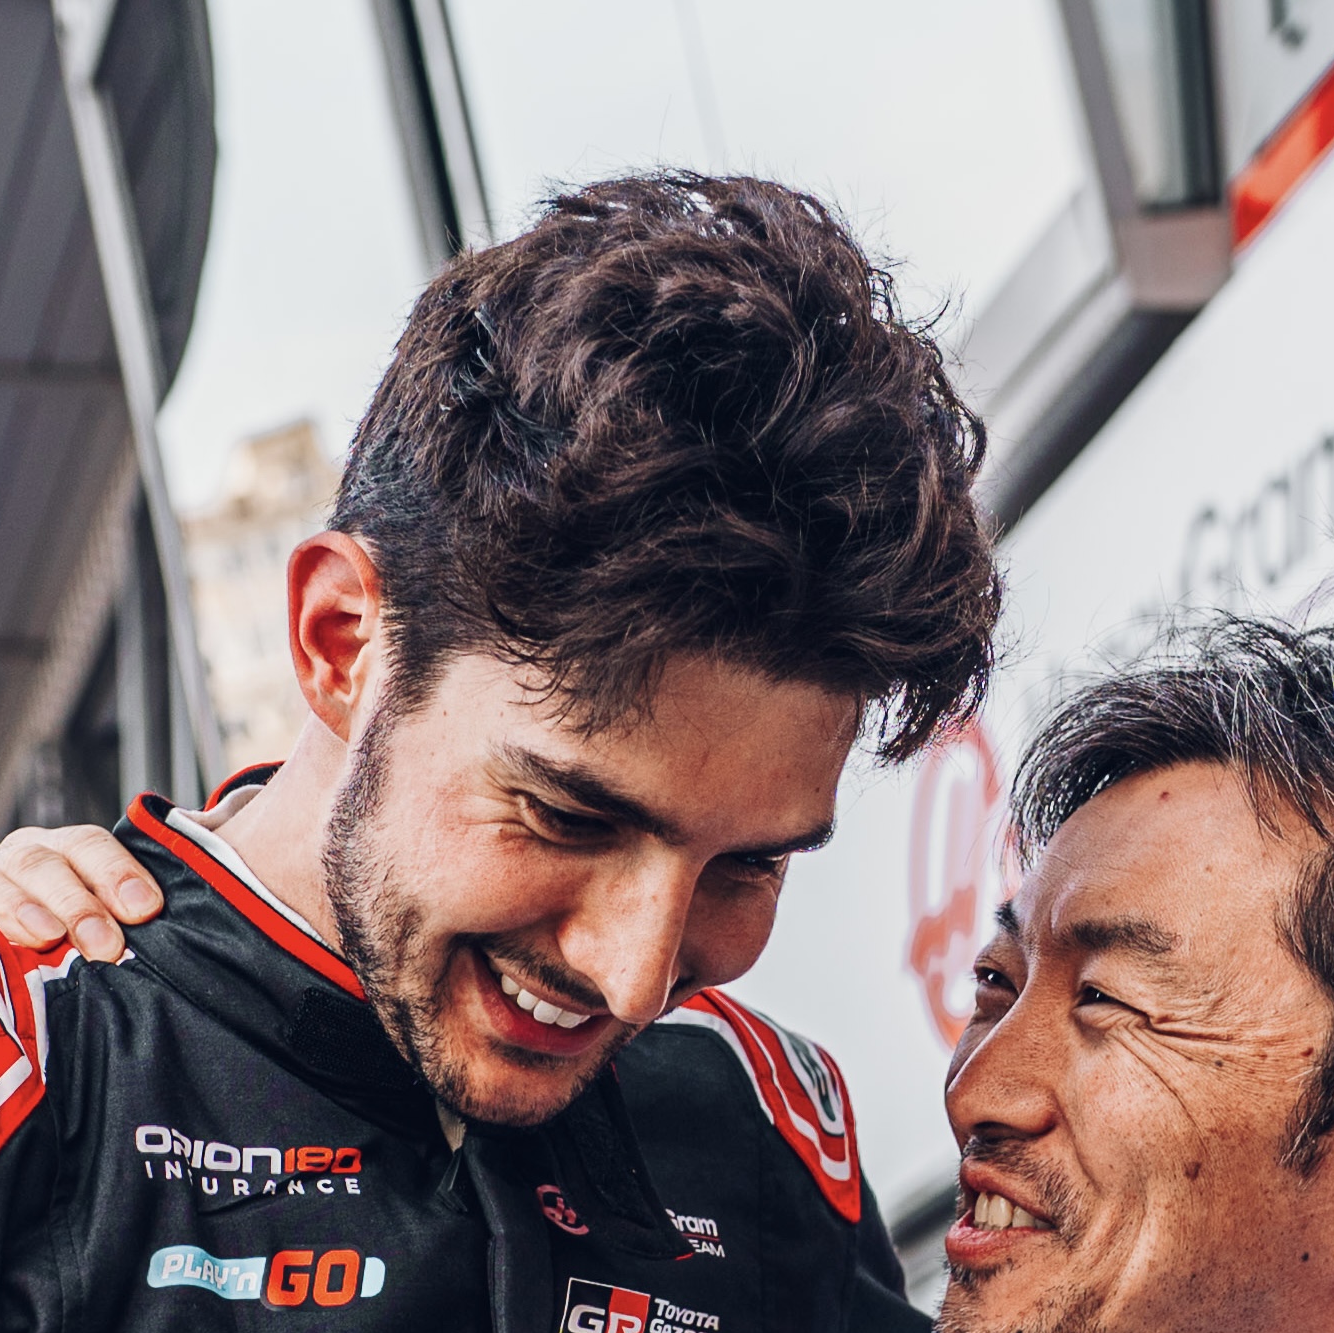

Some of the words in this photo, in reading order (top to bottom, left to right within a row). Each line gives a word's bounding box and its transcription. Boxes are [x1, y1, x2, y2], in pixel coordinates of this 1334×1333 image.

[144, 1160, 361, 1196] INURANCE
[687, 1238, 726, 1258] EAM
[267, 1249, 370, 1307] GO
[655, 1298, 720, 1331] TOYOTA
